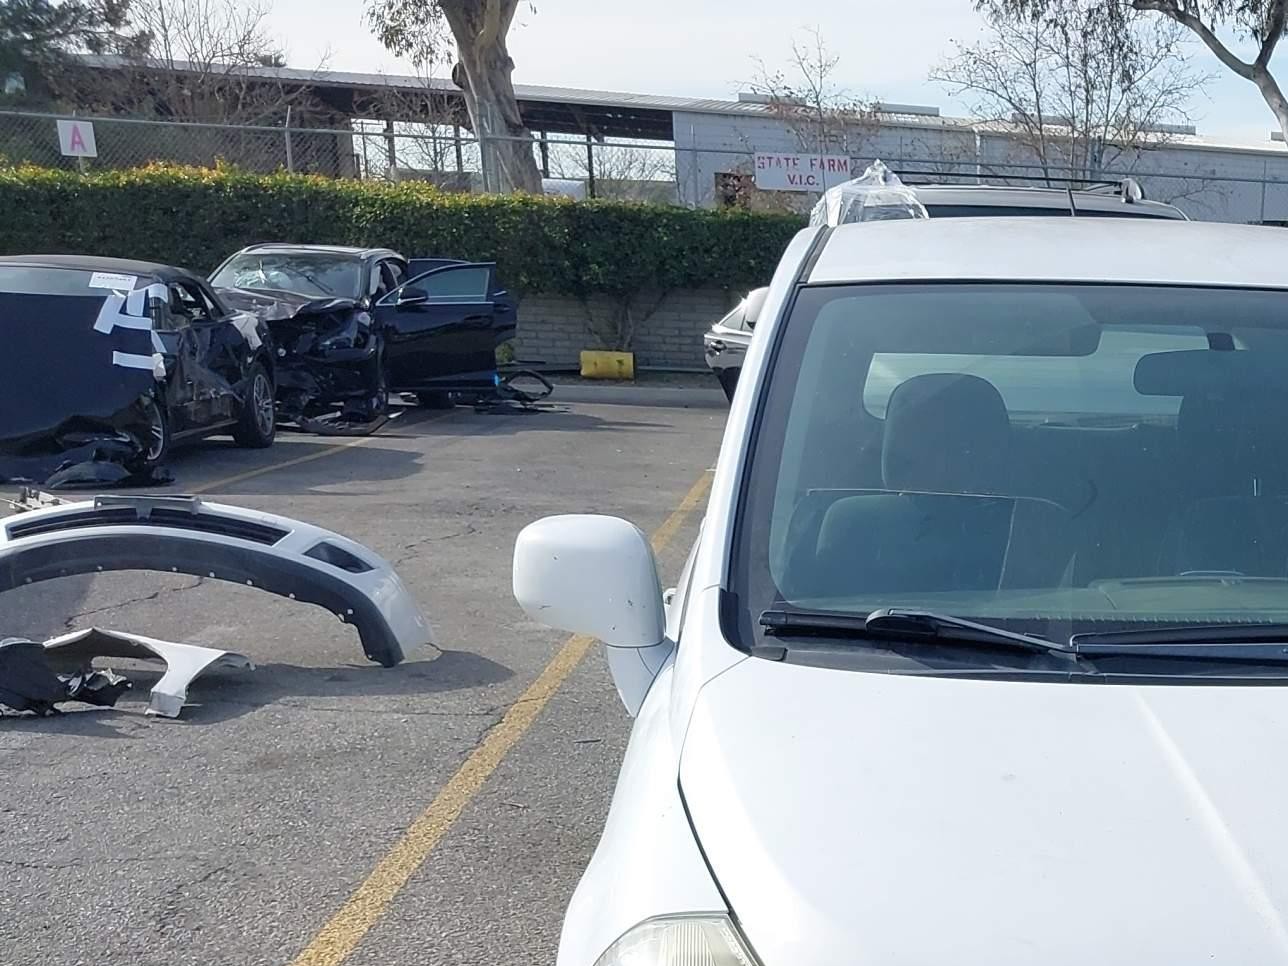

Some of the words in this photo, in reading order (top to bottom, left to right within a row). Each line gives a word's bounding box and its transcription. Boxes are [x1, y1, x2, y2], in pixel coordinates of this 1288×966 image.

[70, 124, 88, 153] A
[757, 156, 801, 170] STATE
[809, 157, 849, 173] FARM
[787, 173, 820, 187] V.I.C.
